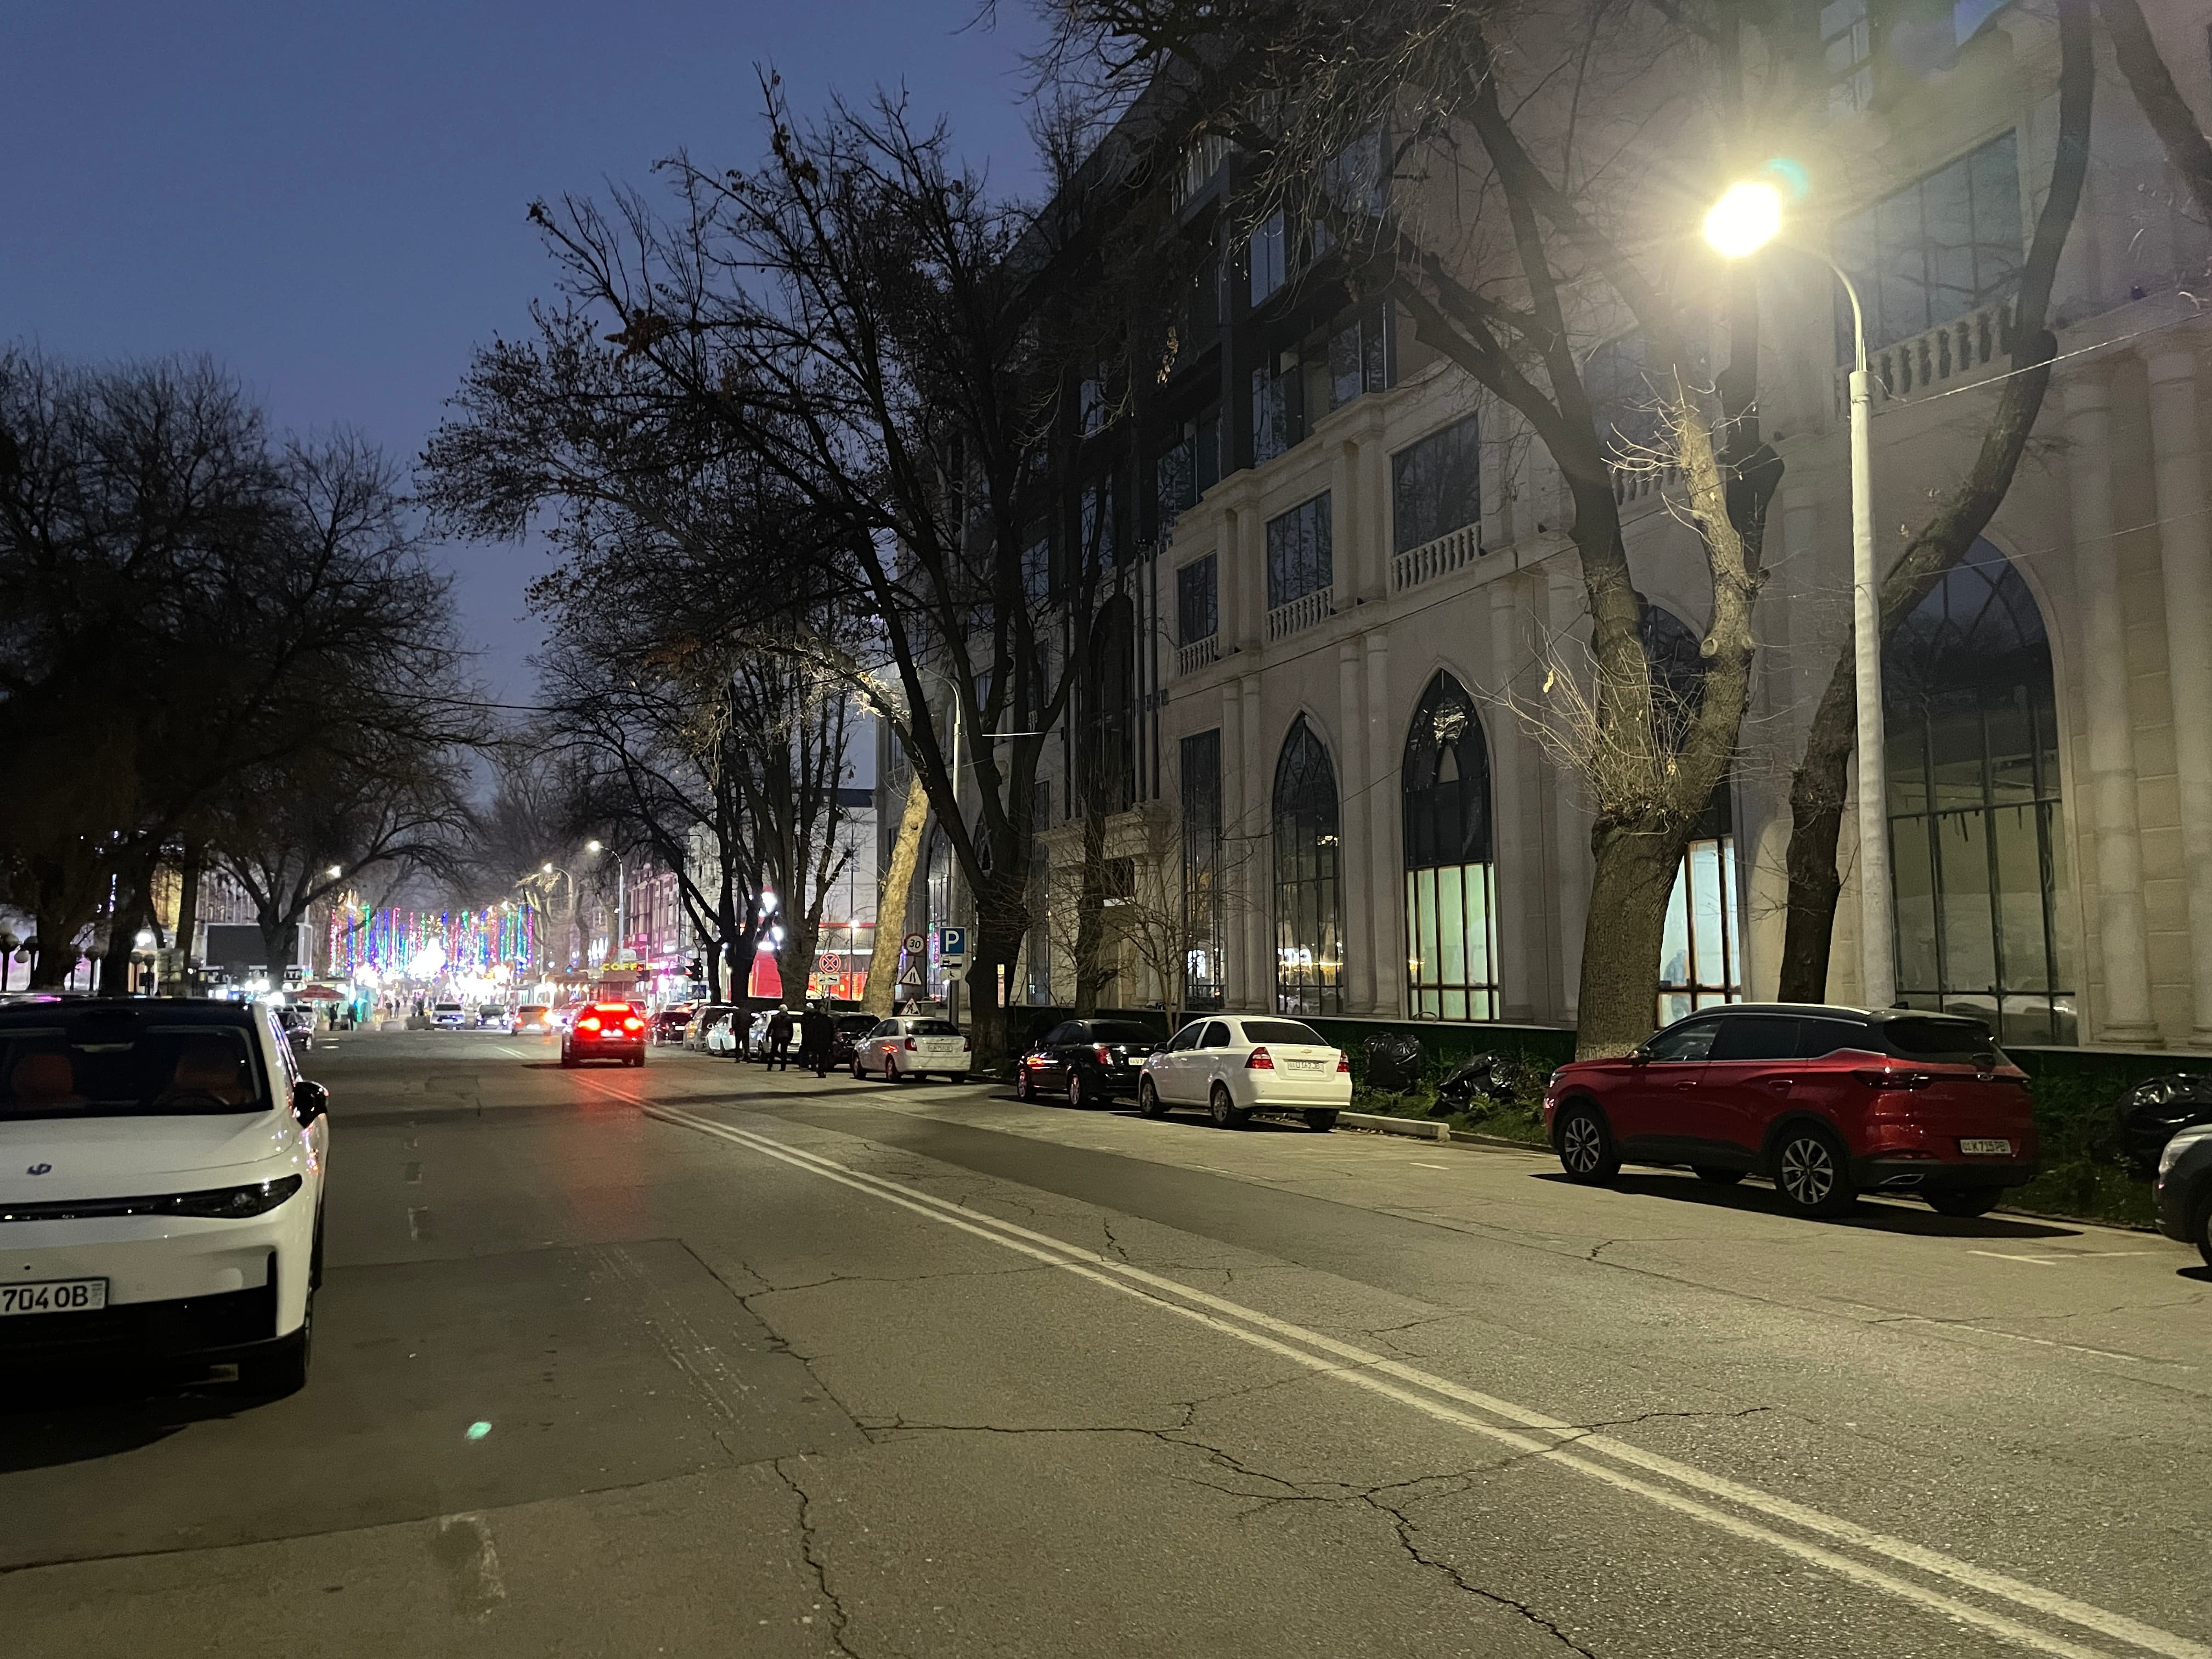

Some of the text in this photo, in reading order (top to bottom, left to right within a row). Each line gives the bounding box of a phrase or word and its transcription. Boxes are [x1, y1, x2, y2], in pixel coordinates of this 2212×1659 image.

[909, 939, 921, 949] 30
[945, 930, 960, 952] P
[602, 962, 653, 970] COFF
